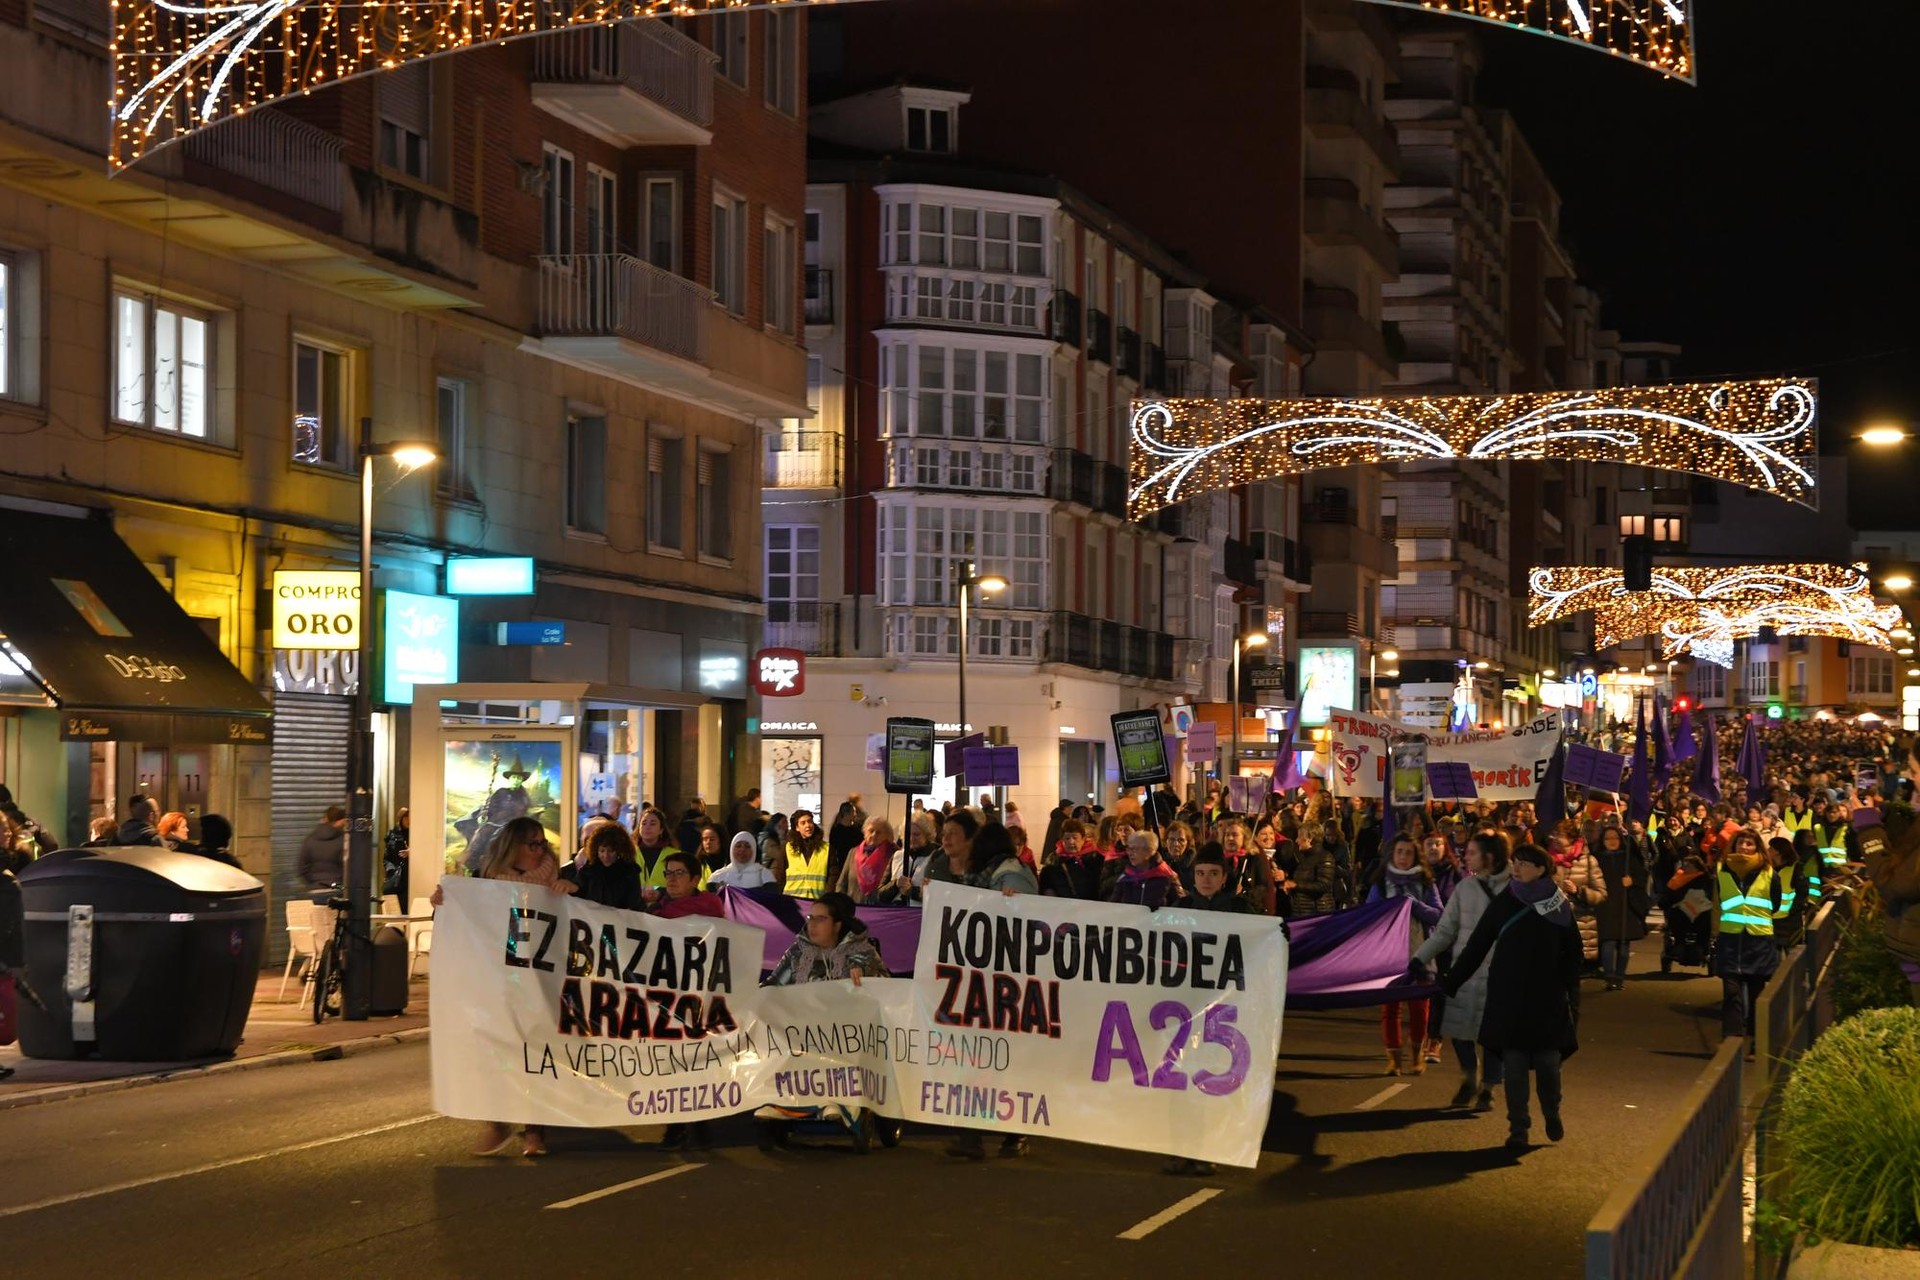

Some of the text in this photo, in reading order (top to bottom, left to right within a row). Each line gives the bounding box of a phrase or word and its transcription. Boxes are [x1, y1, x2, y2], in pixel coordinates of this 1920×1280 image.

[279, 586, 360, 599] COMPRO
[288, 614, 353, 634] ORO
[760, 722, 817, 730] OMAICA
[506, 907, 732, 993] EZ BAZARA
[938, 906, 1246, 991] KONPONBIDEA
[558, 977, 738, 1040] ARAZOA
[934, 963, 1062, 1039] ZARA!
[523, 1041, 558, 1079] LA
[565, 1037, 721, 1077] VERGÜENZA
[766, 1024, 782, 1058] A
[785, 1022, 889, 1060] CAMBIAR
[895, 1027, 919, 1064] DE
[927, 1030, 1010, 1071] BANDO
[1091, 1000, 1251, 1096] A25
[627, 1081, 742, 1115] GASTEIZKO
[920, 1081, 1051, 1126] FEMINISTA
